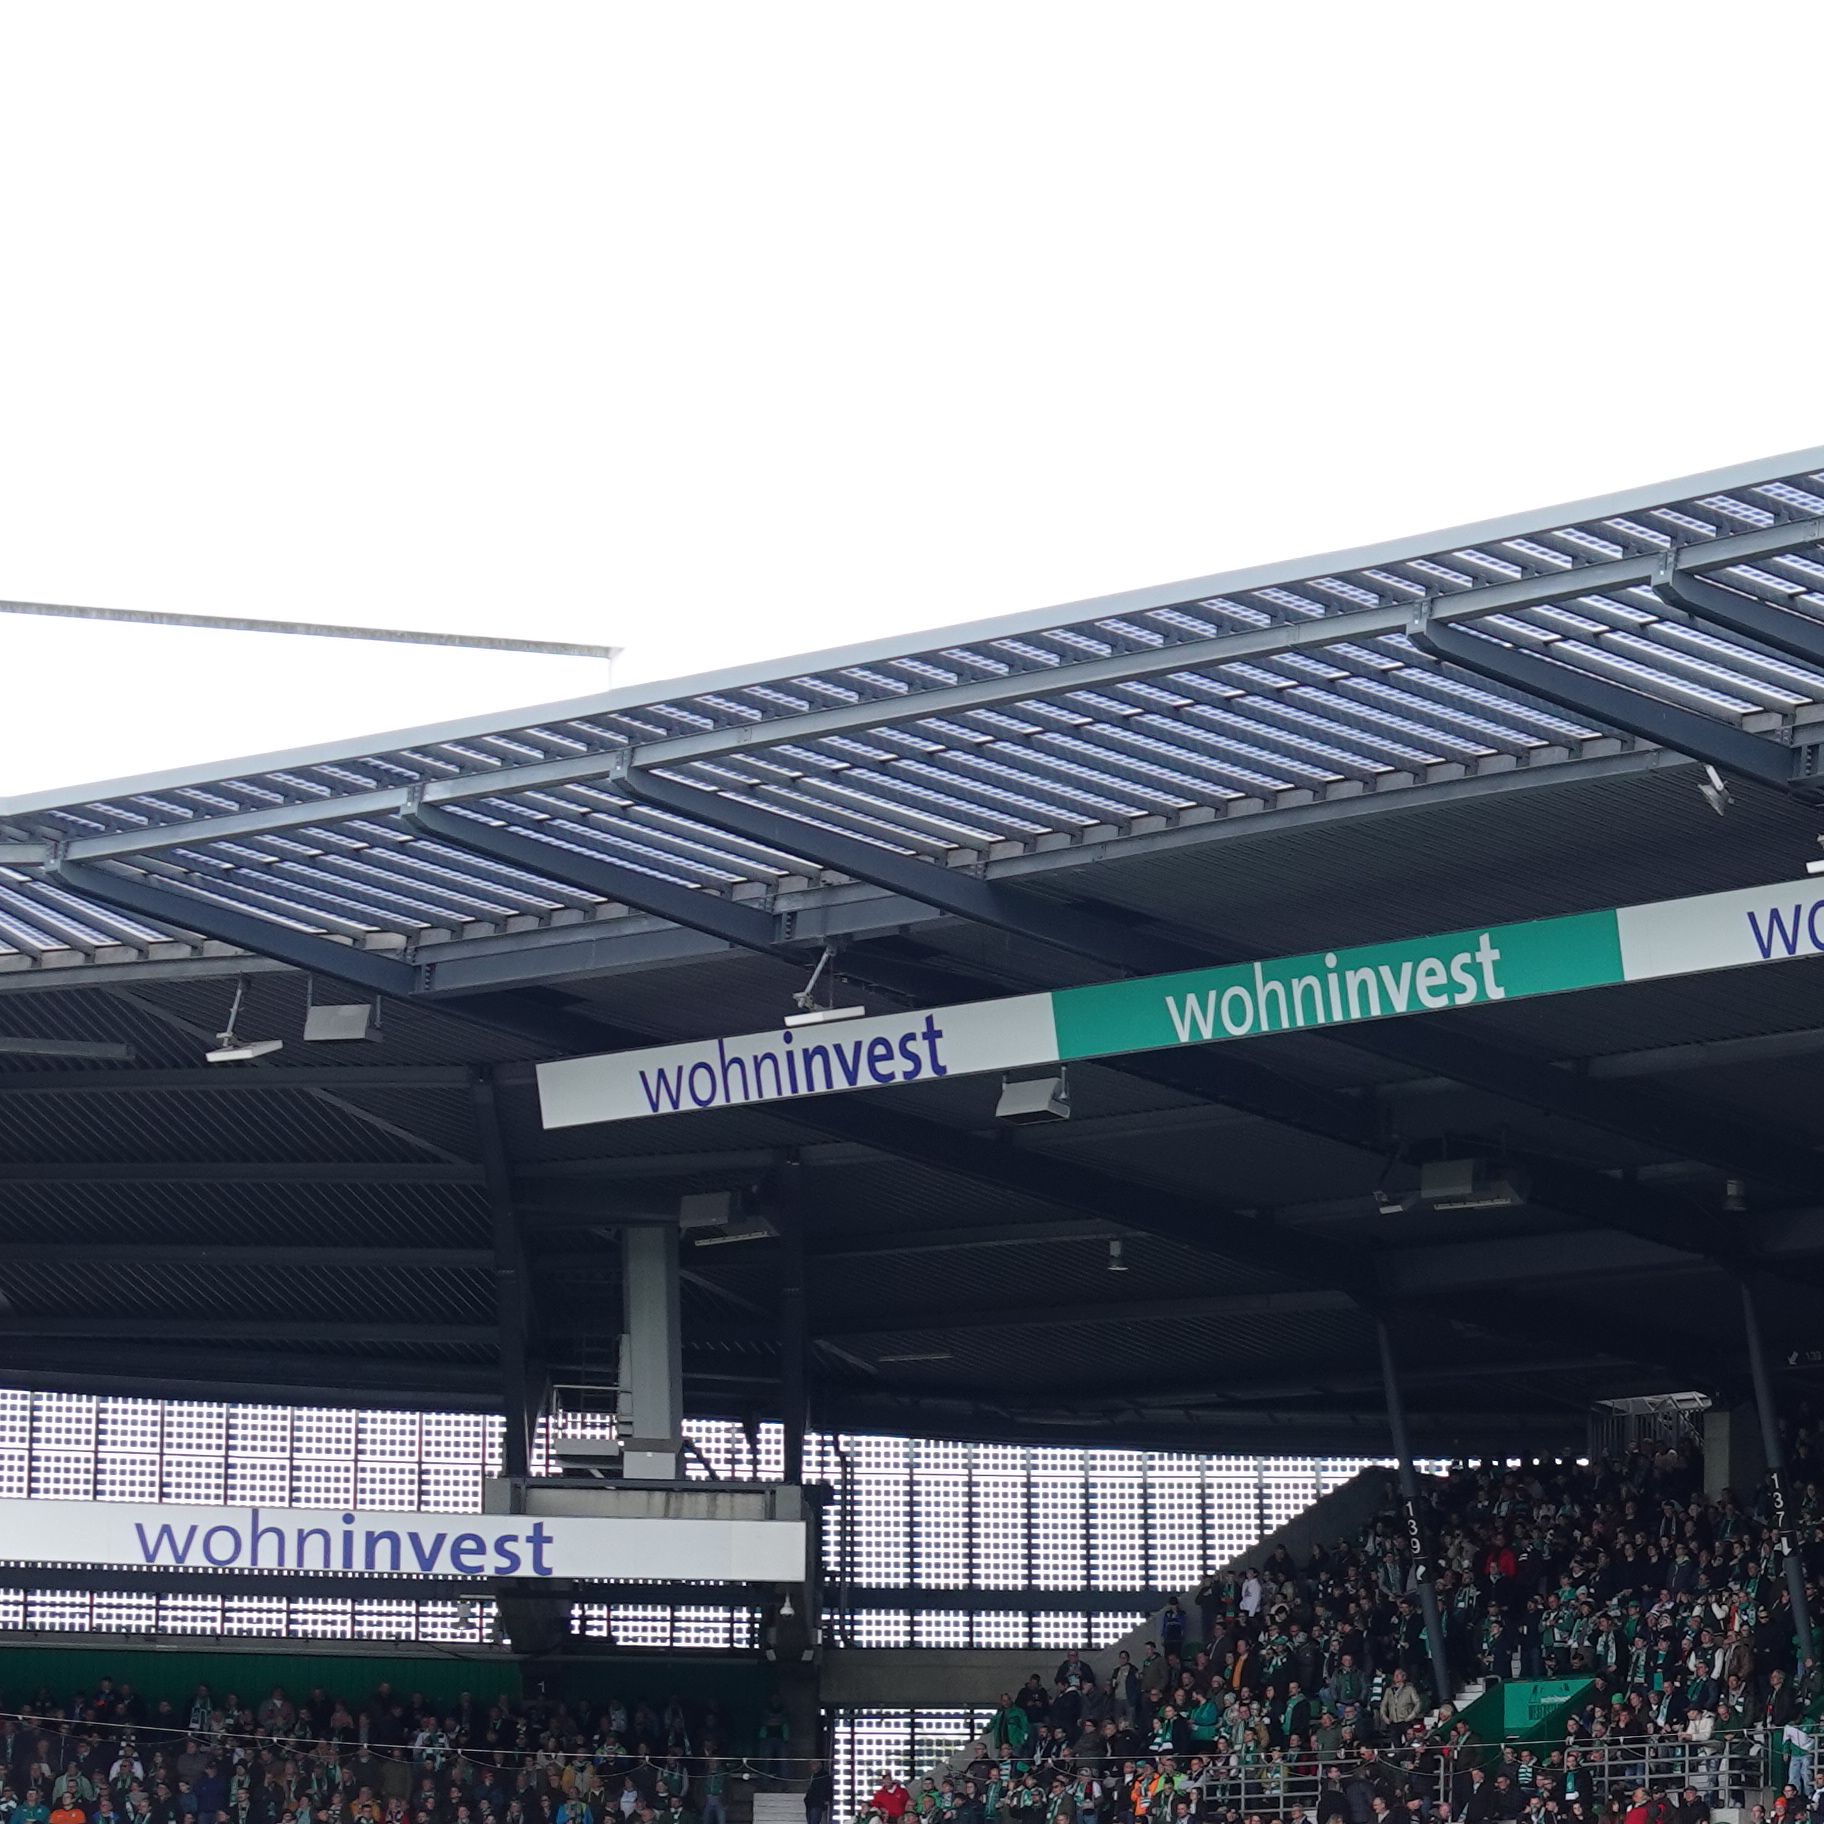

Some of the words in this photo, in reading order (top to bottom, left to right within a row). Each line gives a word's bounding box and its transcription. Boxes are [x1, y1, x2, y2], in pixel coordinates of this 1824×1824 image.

[1165, 932, 1505, 1043] wohninvest
[640, 1015, 947, 1113] wohninvest
[1405, 1500, 1421, 1554] 139
[1771, 1472, 1785, 1528] 137
[134, 1508, 554, 1576] wohninvest
